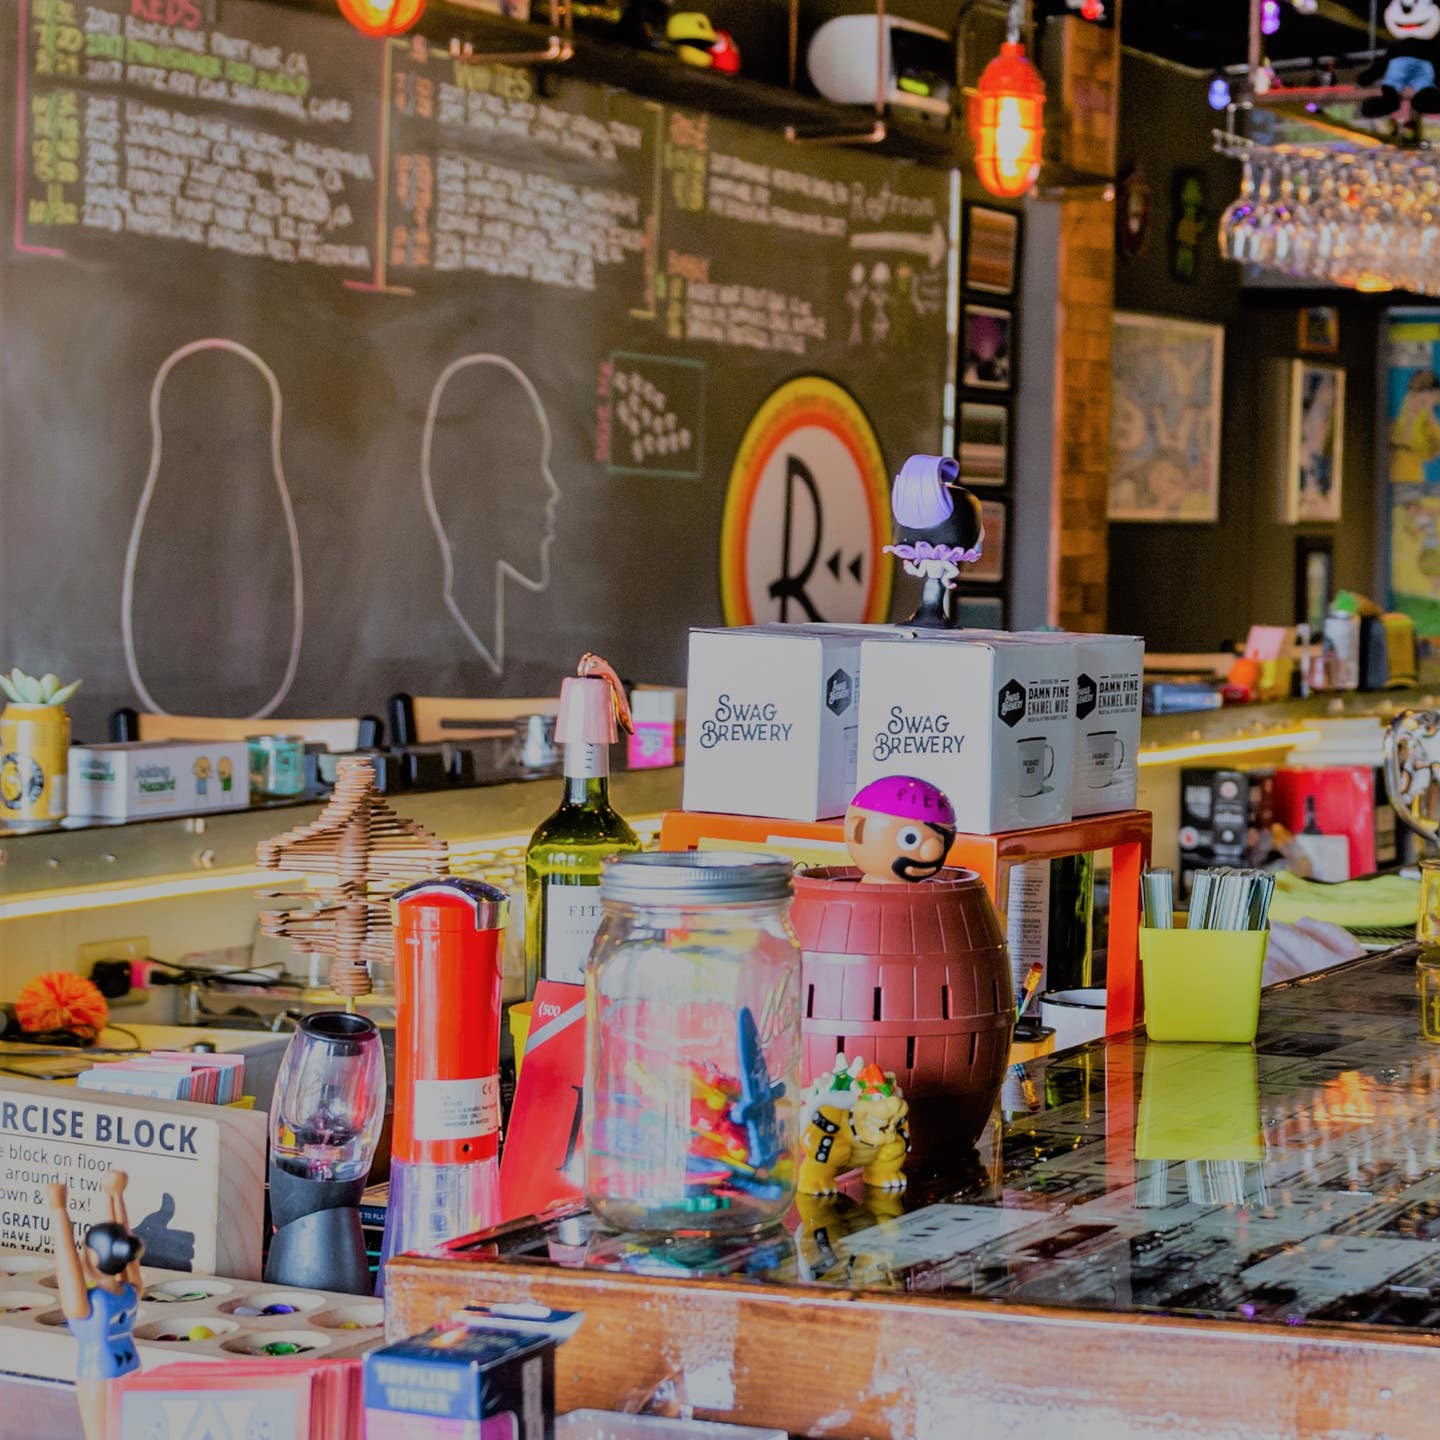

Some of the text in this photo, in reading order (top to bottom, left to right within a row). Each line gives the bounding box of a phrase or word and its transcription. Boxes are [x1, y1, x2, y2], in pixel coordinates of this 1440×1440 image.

[1028, 687, 1050, 700] DAMN
[1052, 685, 1069, 698] FINE
[1100, 680, 1138, 694] DAMN FINE
[1028, 699, 1069, 716] ENAMEL MUG
[1098, 694, 1121, 709] ENAMEL
[1124, 693, 1138, 707] MUG
[96, 1113, 199, 1155] BLOCK
[9, 1143, 113, 1172] block on floor
[6, 1167, 60, 1187] around
[65, 1172, 74, 1189] it
[33, 1189, 44, 1205] &
[373, 1212, 386, 1221] PLA
[2, 1229, 30, 1243] HAVE
